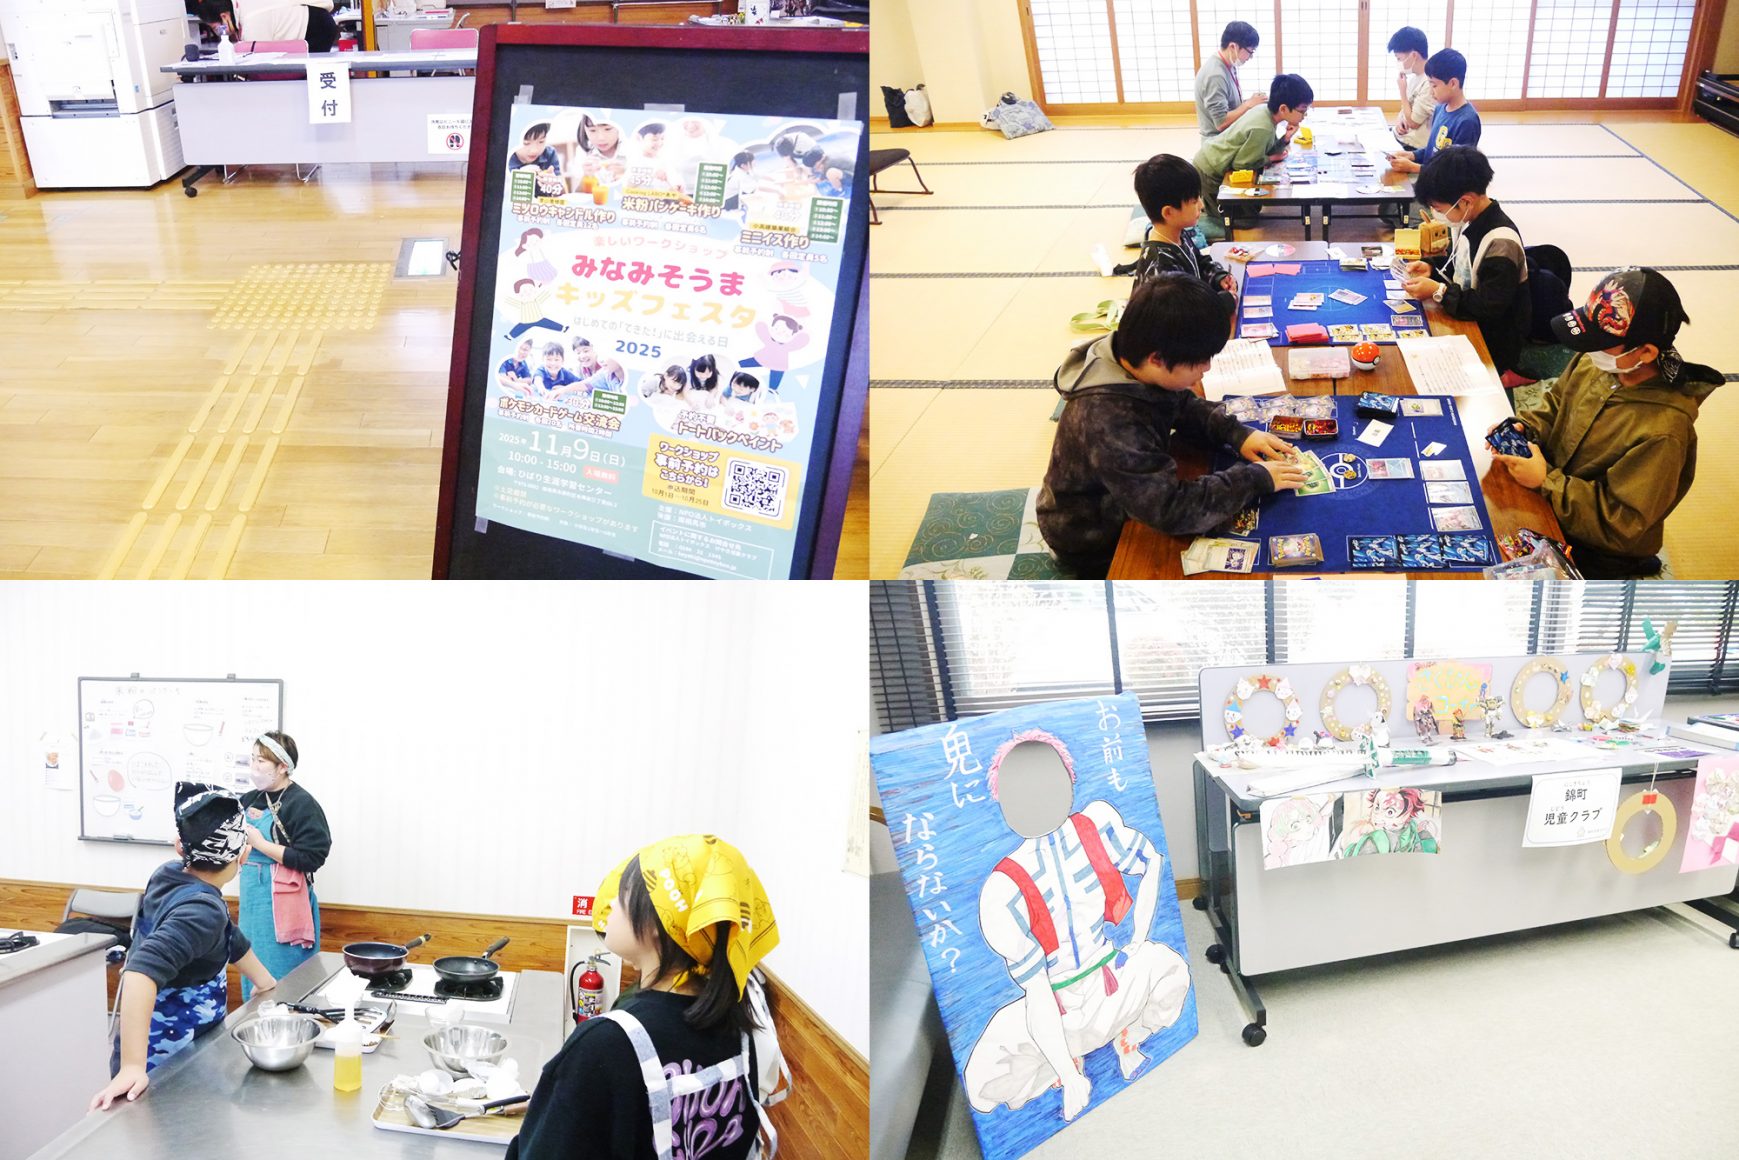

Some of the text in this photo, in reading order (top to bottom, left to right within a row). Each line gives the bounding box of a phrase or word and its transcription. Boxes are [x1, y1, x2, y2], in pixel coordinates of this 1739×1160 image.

[320, 71, 338, 116] 受付
[512, 202, 617, 224] ミツロウキャンドル作り
[622, 196, 721, 219] 米粉パンケーキ作り
[593, 235, 728, 260] 楽しいワークショップ
[741, 230, 811, 250] ミニイス作り
[572, 255, 745, 296] みなみそうま
[556, 282, 756, 329] キッズフェスタ
[615, 340, 662, 358] 2025
[499, 396, 621, 432] ポケモンカードゲーム交流会
[508, 450, 538, 465] 10:00
[546, 459, 577, 474] 15:00
[659, 441, 720, 462] ワークショップ
[654, 452, 720, 478] 事前予約は
[1095, 700, 1128, 792] お前も
[940, 724, 986, 809] 鬼に
[1565, 788, 1588, 802] 錦町
[1544, 807, 1604, 826] 児童クラブ
[659, 868, 689, 912] POOH
